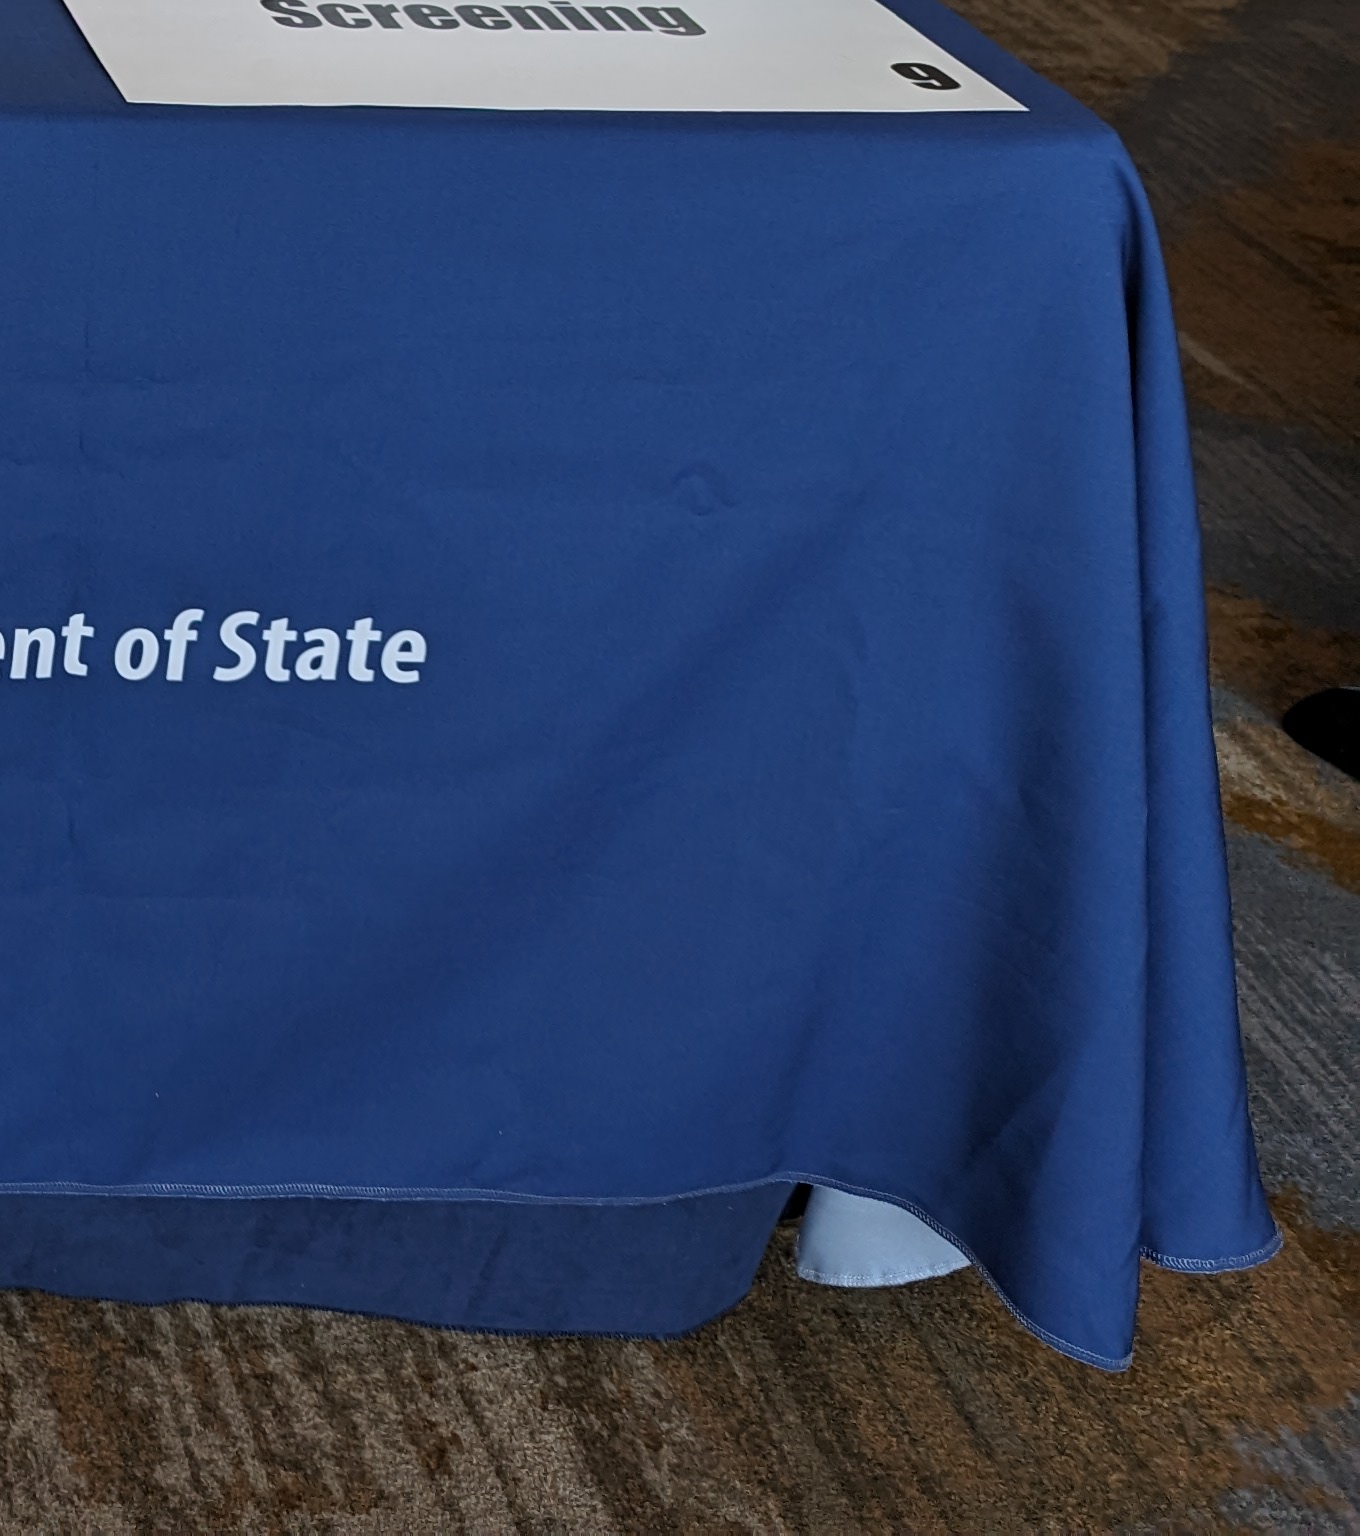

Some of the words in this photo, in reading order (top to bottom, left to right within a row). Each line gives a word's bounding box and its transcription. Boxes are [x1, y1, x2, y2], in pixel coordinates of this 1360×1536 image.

[891, 61, 962, 91] 9
[114, 609, 203, 682] of
[213, 611, 428, 685] State
